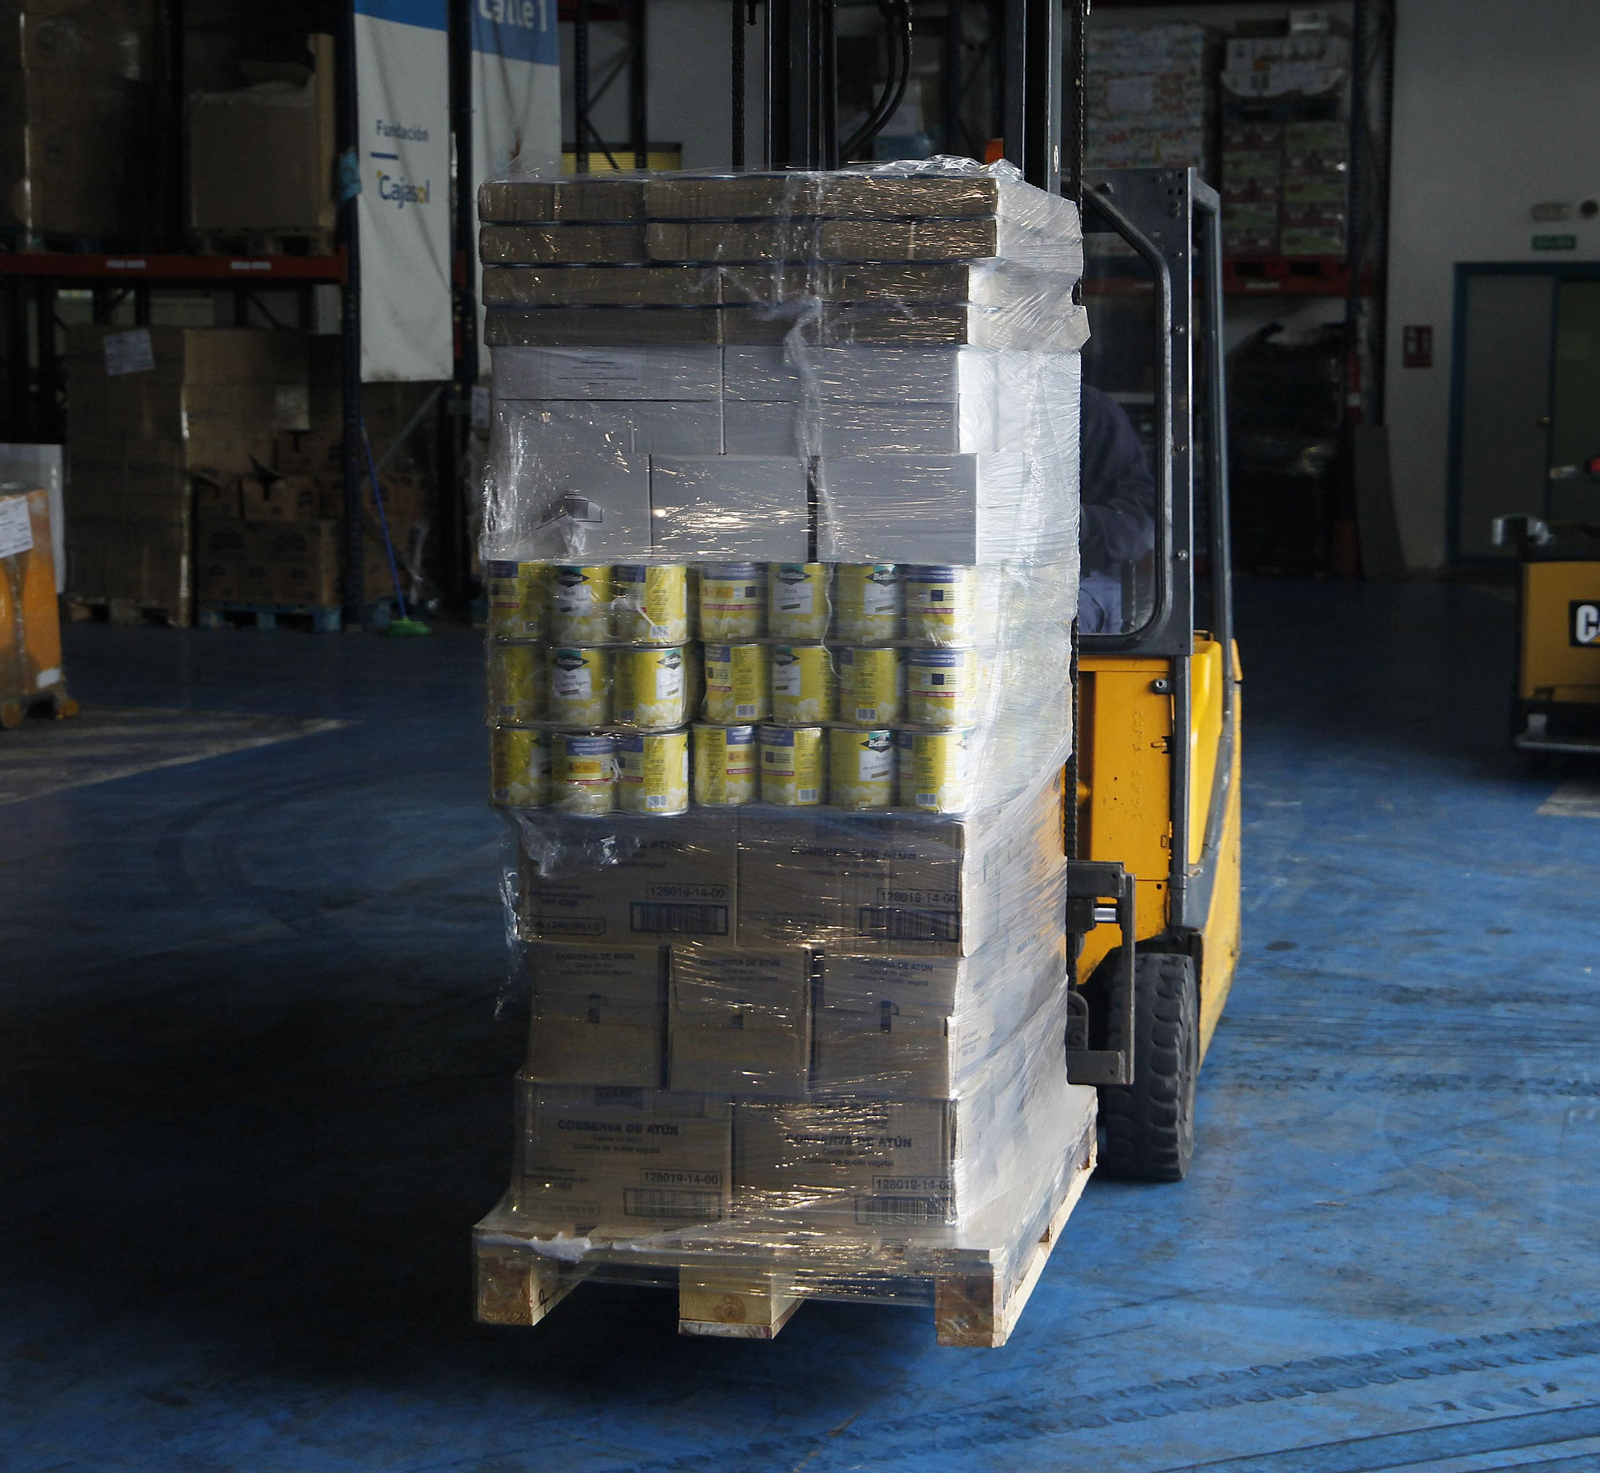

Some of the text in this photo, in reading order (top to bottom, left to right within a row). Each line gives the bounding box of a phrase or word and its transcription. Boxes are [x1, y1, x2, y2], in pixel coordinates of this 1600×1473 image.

[376, 119, 429, 141] Fundación
[378, 173, 430, 208] Cajasol
[1575, 604, 1600, 644] C
[650, 886, 725, 898] 128019-14-00
[897, 962, 909, 970] DE
[557, 1119, 679, 1136] CONSERVA DE ATÚN
[878, 1135, 912, 1148] ATÚN
[644, 1171, 718, 1185] 128019-14-00
